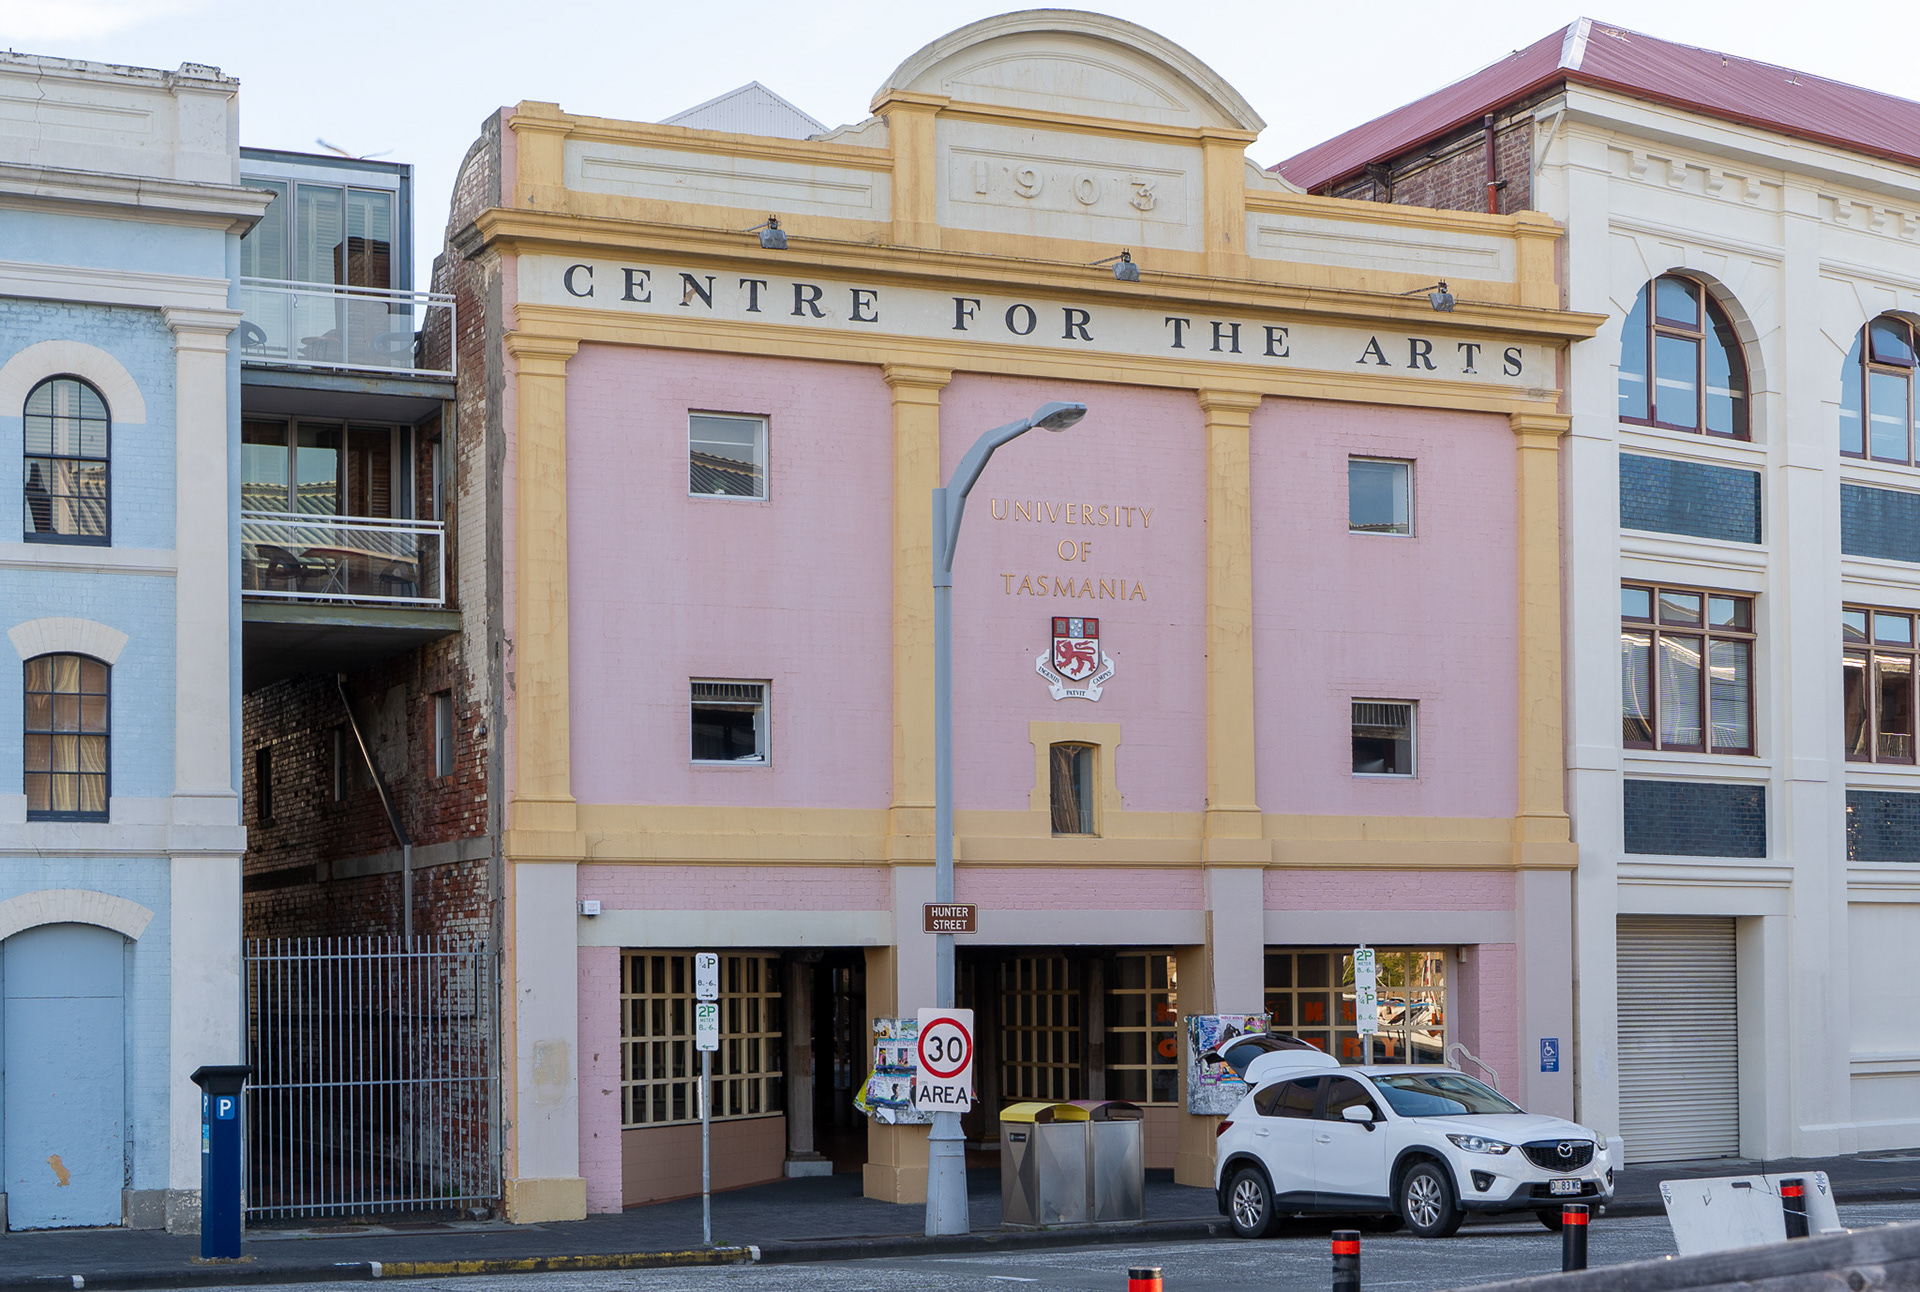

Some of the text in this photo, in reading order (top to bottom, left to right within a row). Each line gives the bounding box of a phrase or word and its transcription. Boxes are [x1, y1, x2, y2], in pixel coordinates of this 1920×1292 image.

[975, 160, 1157, 211] 1903
[563, 263, 1523, 377] CENTRE FOR THE ARTS
[991, 498, 1154, 528] UNIVERSITY
[1057, 539, 1092, 562] OF
[1001, 573, 1147, 601] TASMANIA
[931, 907, 969, 917] HUNTER
[933, 919, 967, 930] STREET
[1356, 950, 1373, 961] 2P
[698, 1006, 716, 1018] 2P
[928, 1036, 963, 1063] 30
[919, 1086, 969, 1104] AREA
[220, 1099, 231, 1117] P
